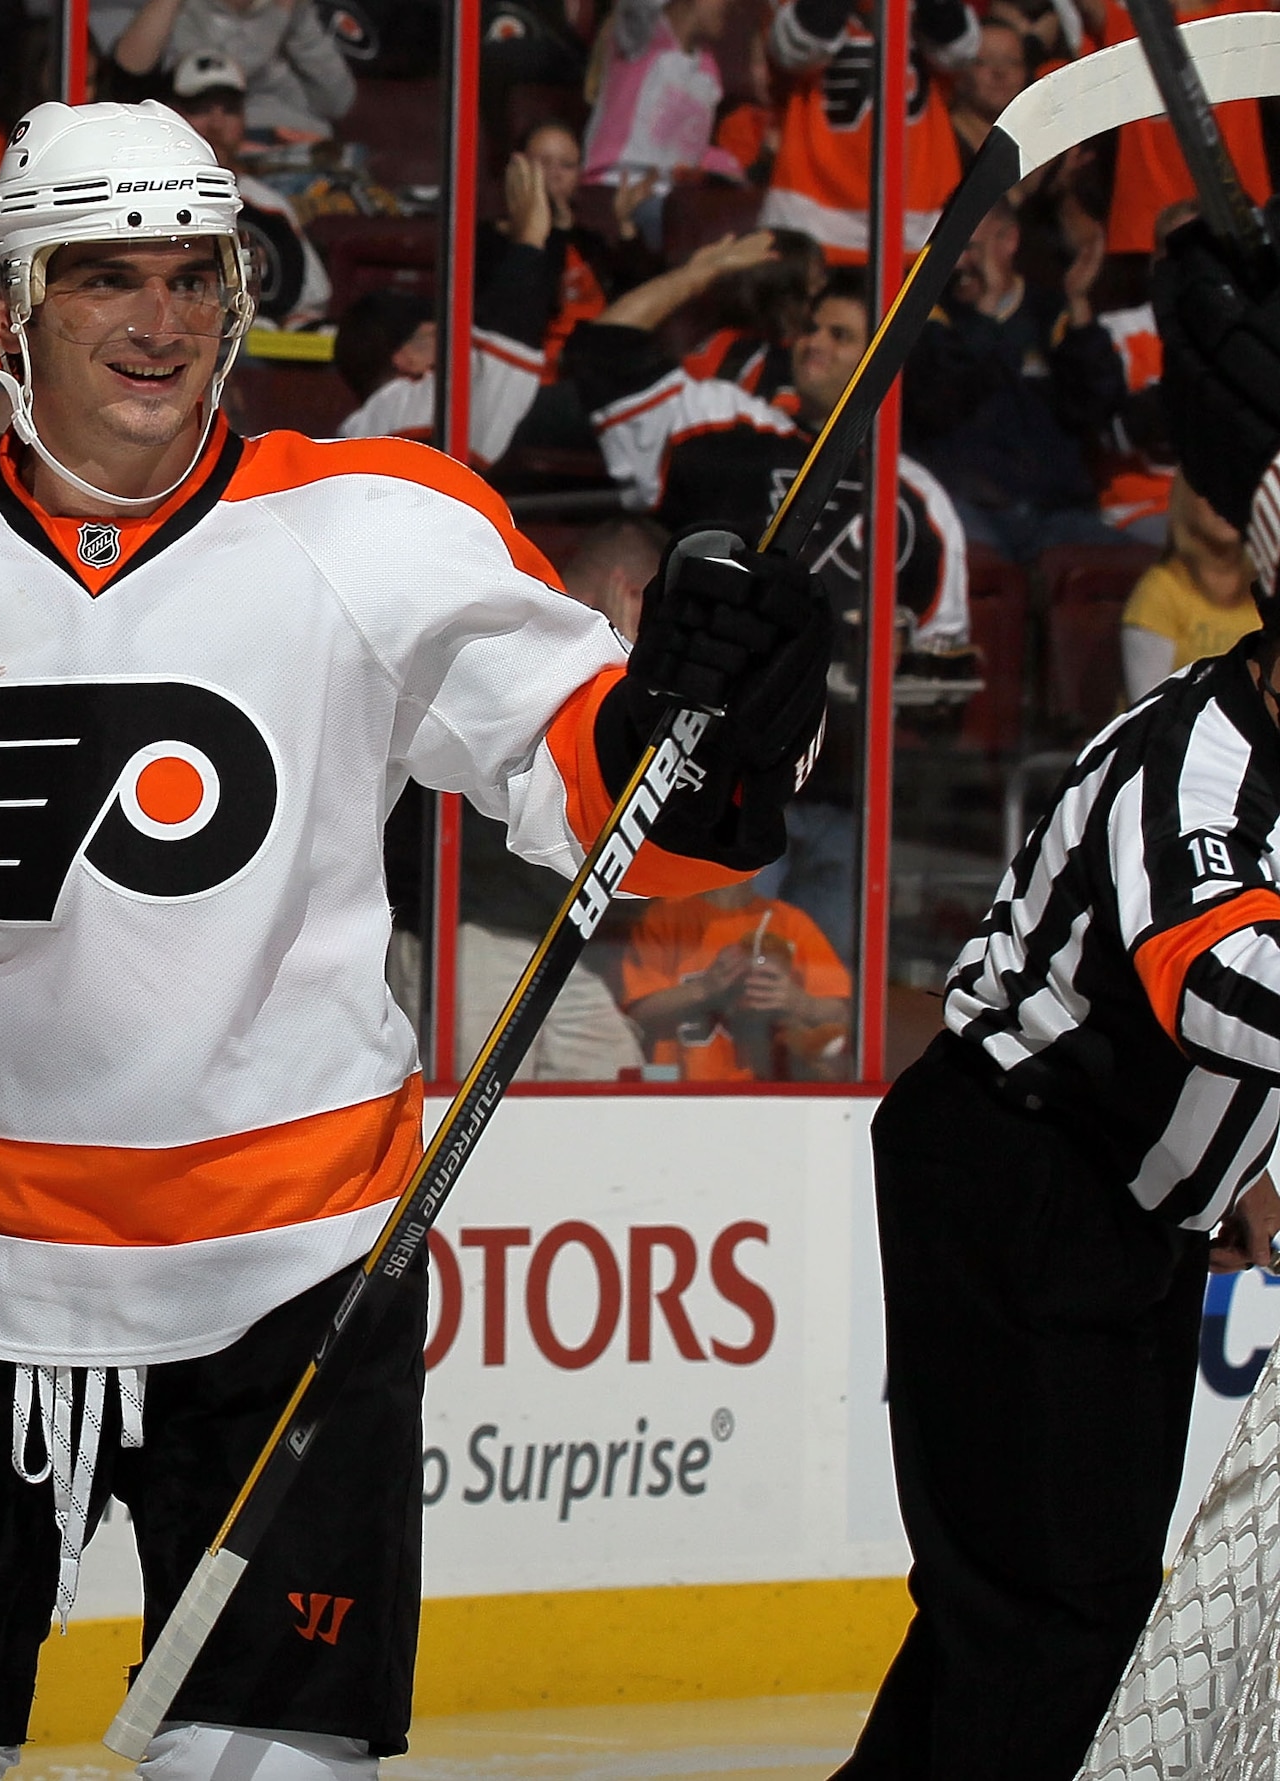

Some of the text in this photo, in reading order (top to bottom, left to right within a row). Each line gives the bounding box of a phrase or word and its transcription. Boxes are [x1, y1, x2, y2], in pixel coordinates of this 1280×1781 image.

[116, 179, 194, 193] BAUER
[86, 534, 112, 558] NHL
[568, 708, 711, 940] BAUER
[1187, 836, 1234, 877] 19
